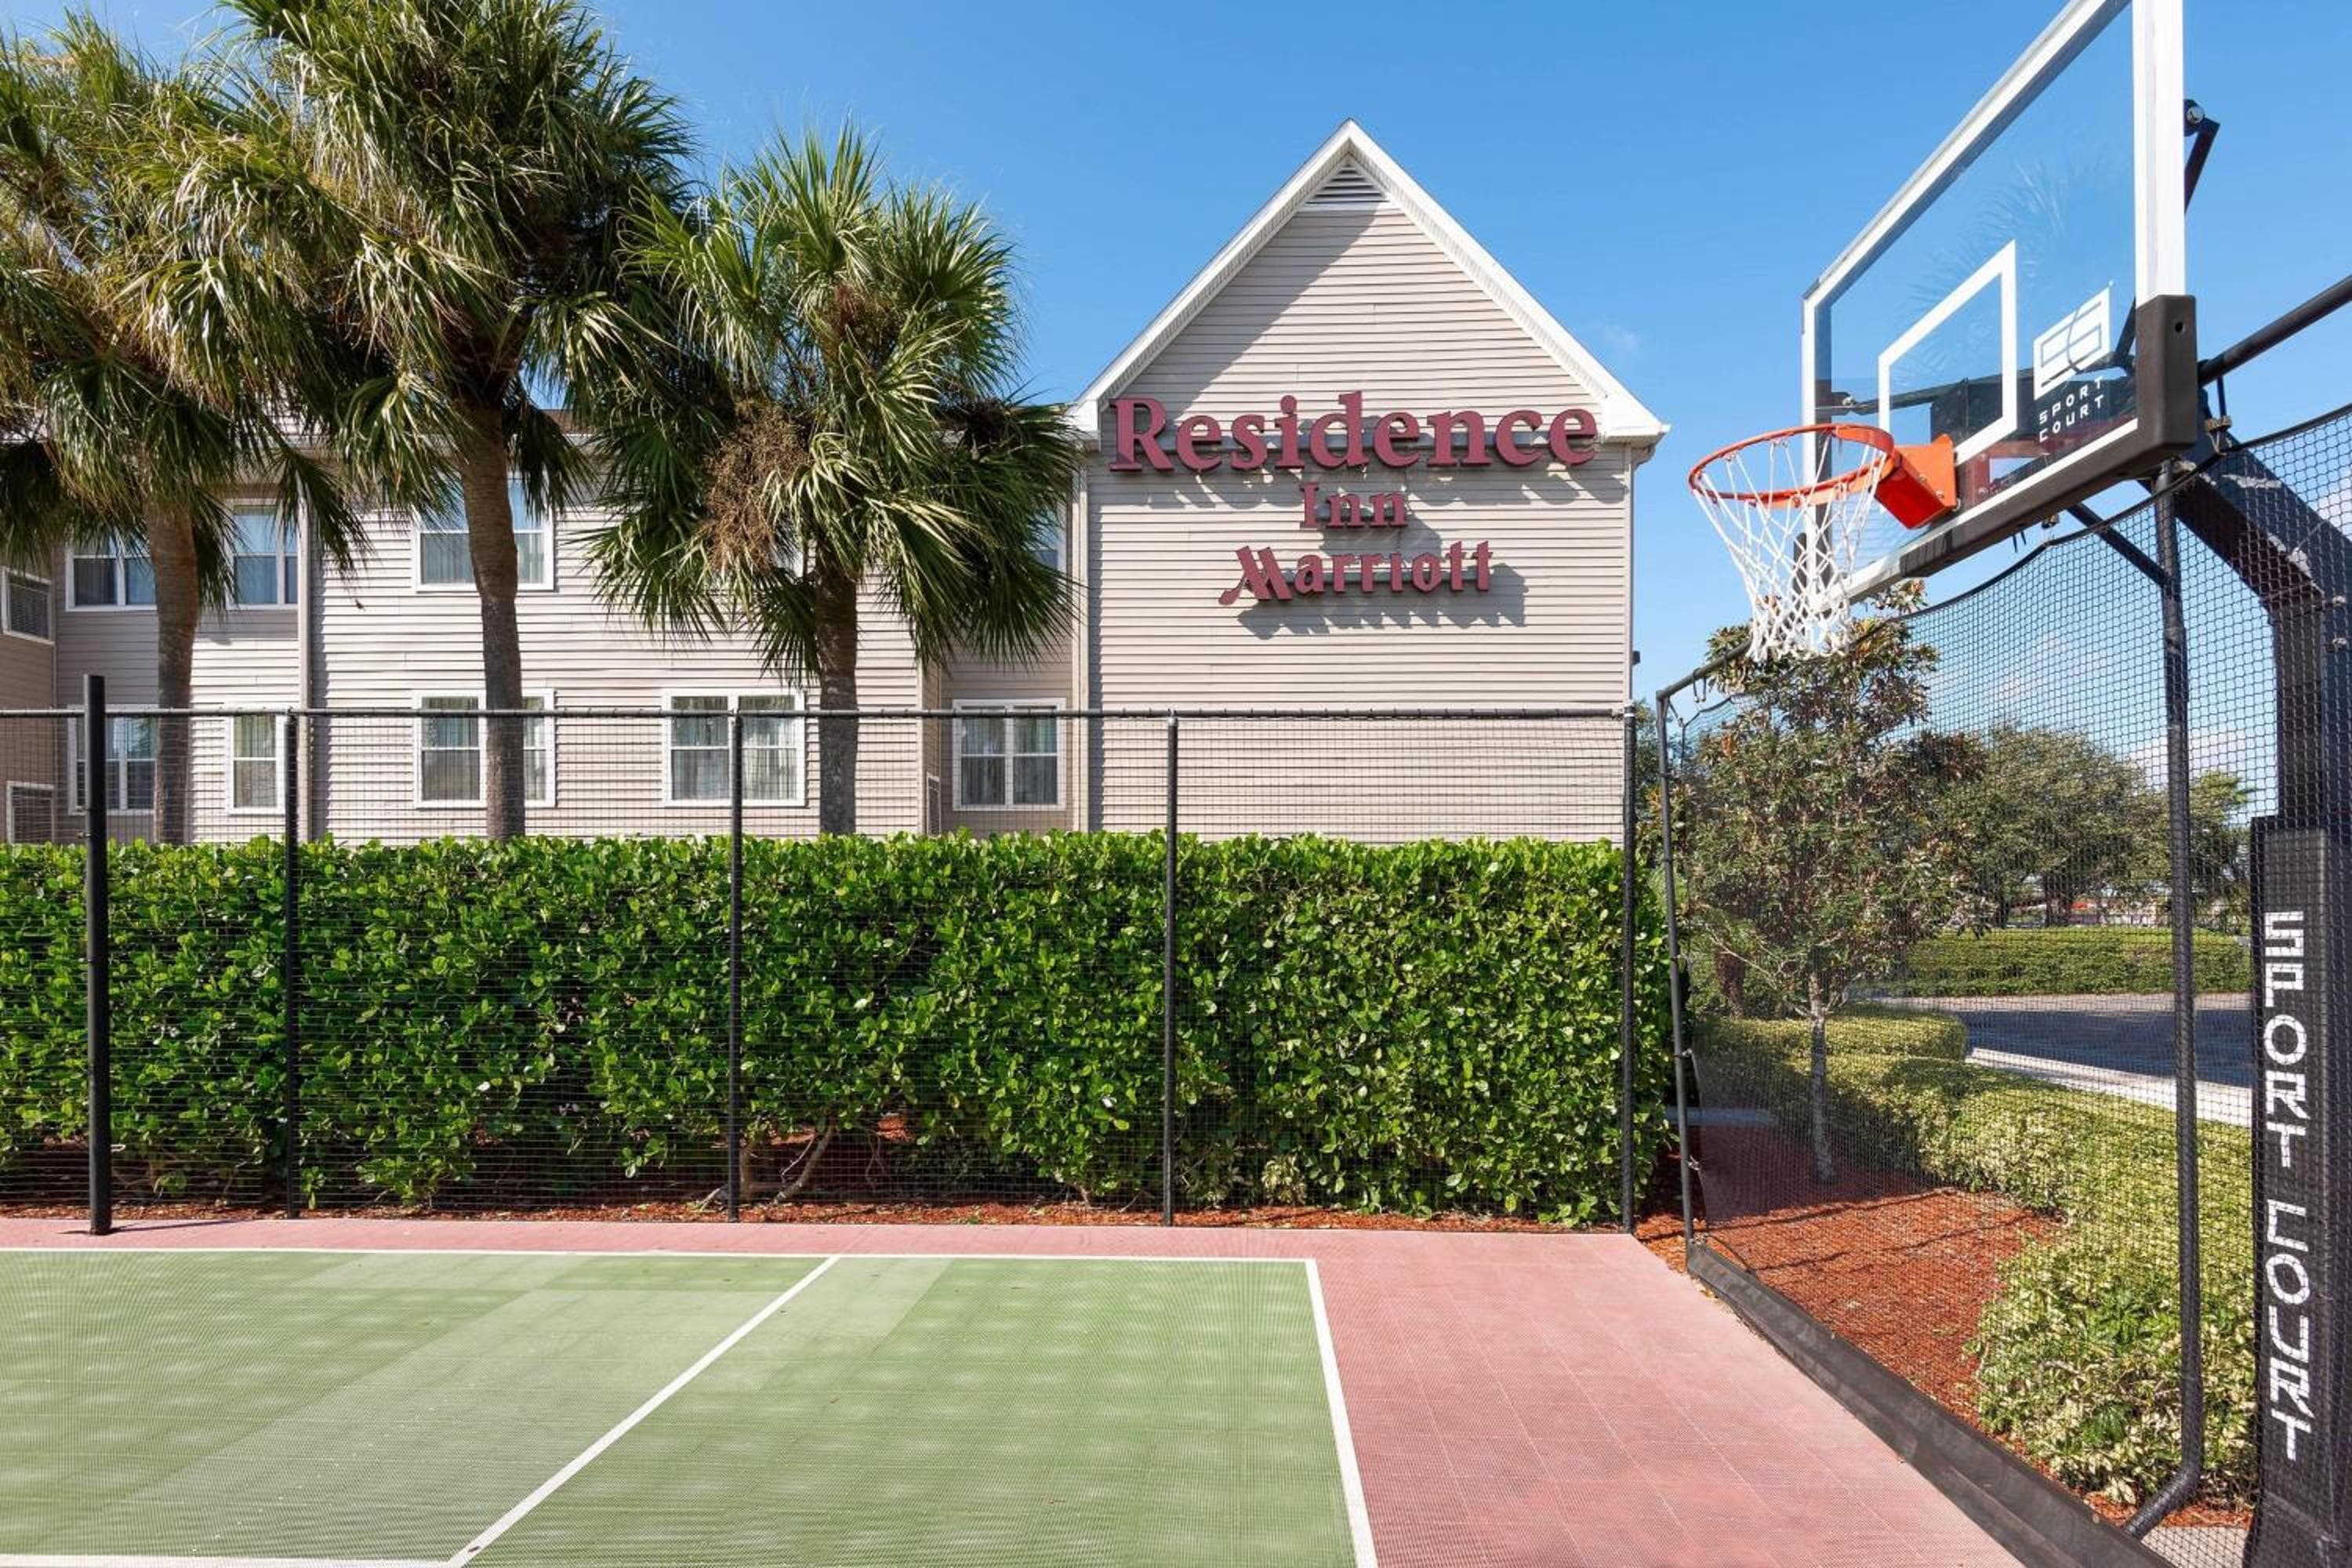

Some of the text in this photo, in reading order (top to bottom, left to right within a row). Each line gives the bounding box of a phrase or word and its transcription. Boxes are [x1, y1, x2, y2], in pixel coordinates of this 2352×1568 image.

[2038, 376, 2104, 424] SPORT
[2038, 394, 2104, 443] COURT
[1109, 391, 1599, 472] Residence
[1299, 481, 1408, 528] Inn
[1218, 540, 1494, 606] Marriott
[2263, 910, 2315, 1463] SPORT COURT
